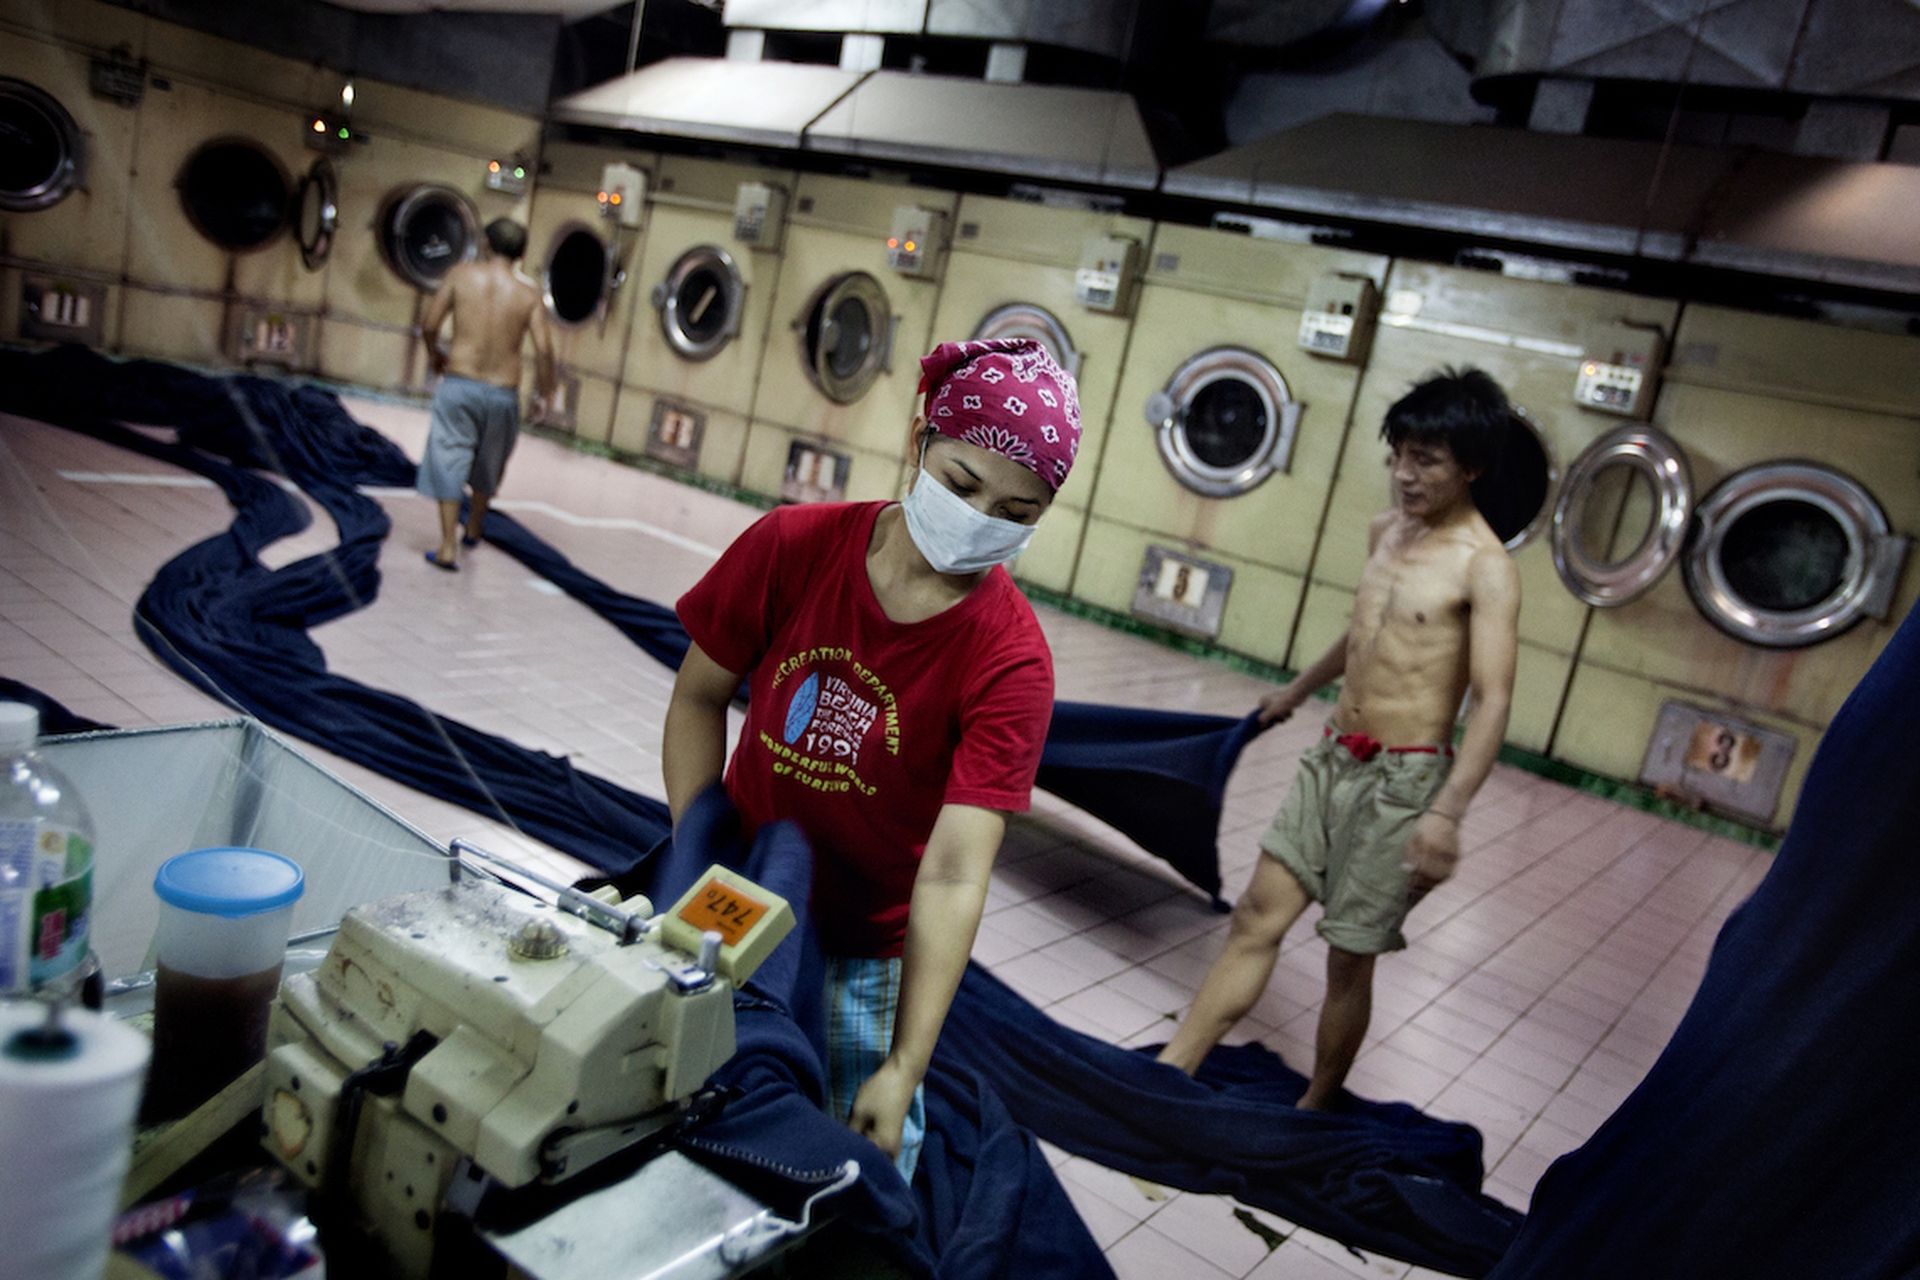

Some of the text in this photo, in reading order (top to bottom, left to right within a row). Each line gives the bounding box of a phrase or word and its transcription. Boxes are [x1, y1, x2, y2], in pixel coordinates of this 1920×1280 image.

[772, 647, 900, 755] RECREATION DEPARTMENT
[819, 690, 873, 735] BEACH
[825, 675, 877, 722] VIRGINIA
[760, 729, 878, 796] WONDERFUL WORLD
[773, 761, 793, 776] OF
[806, 733, 858, 766] 1991
[1709, 729, 1736, 772] 3
